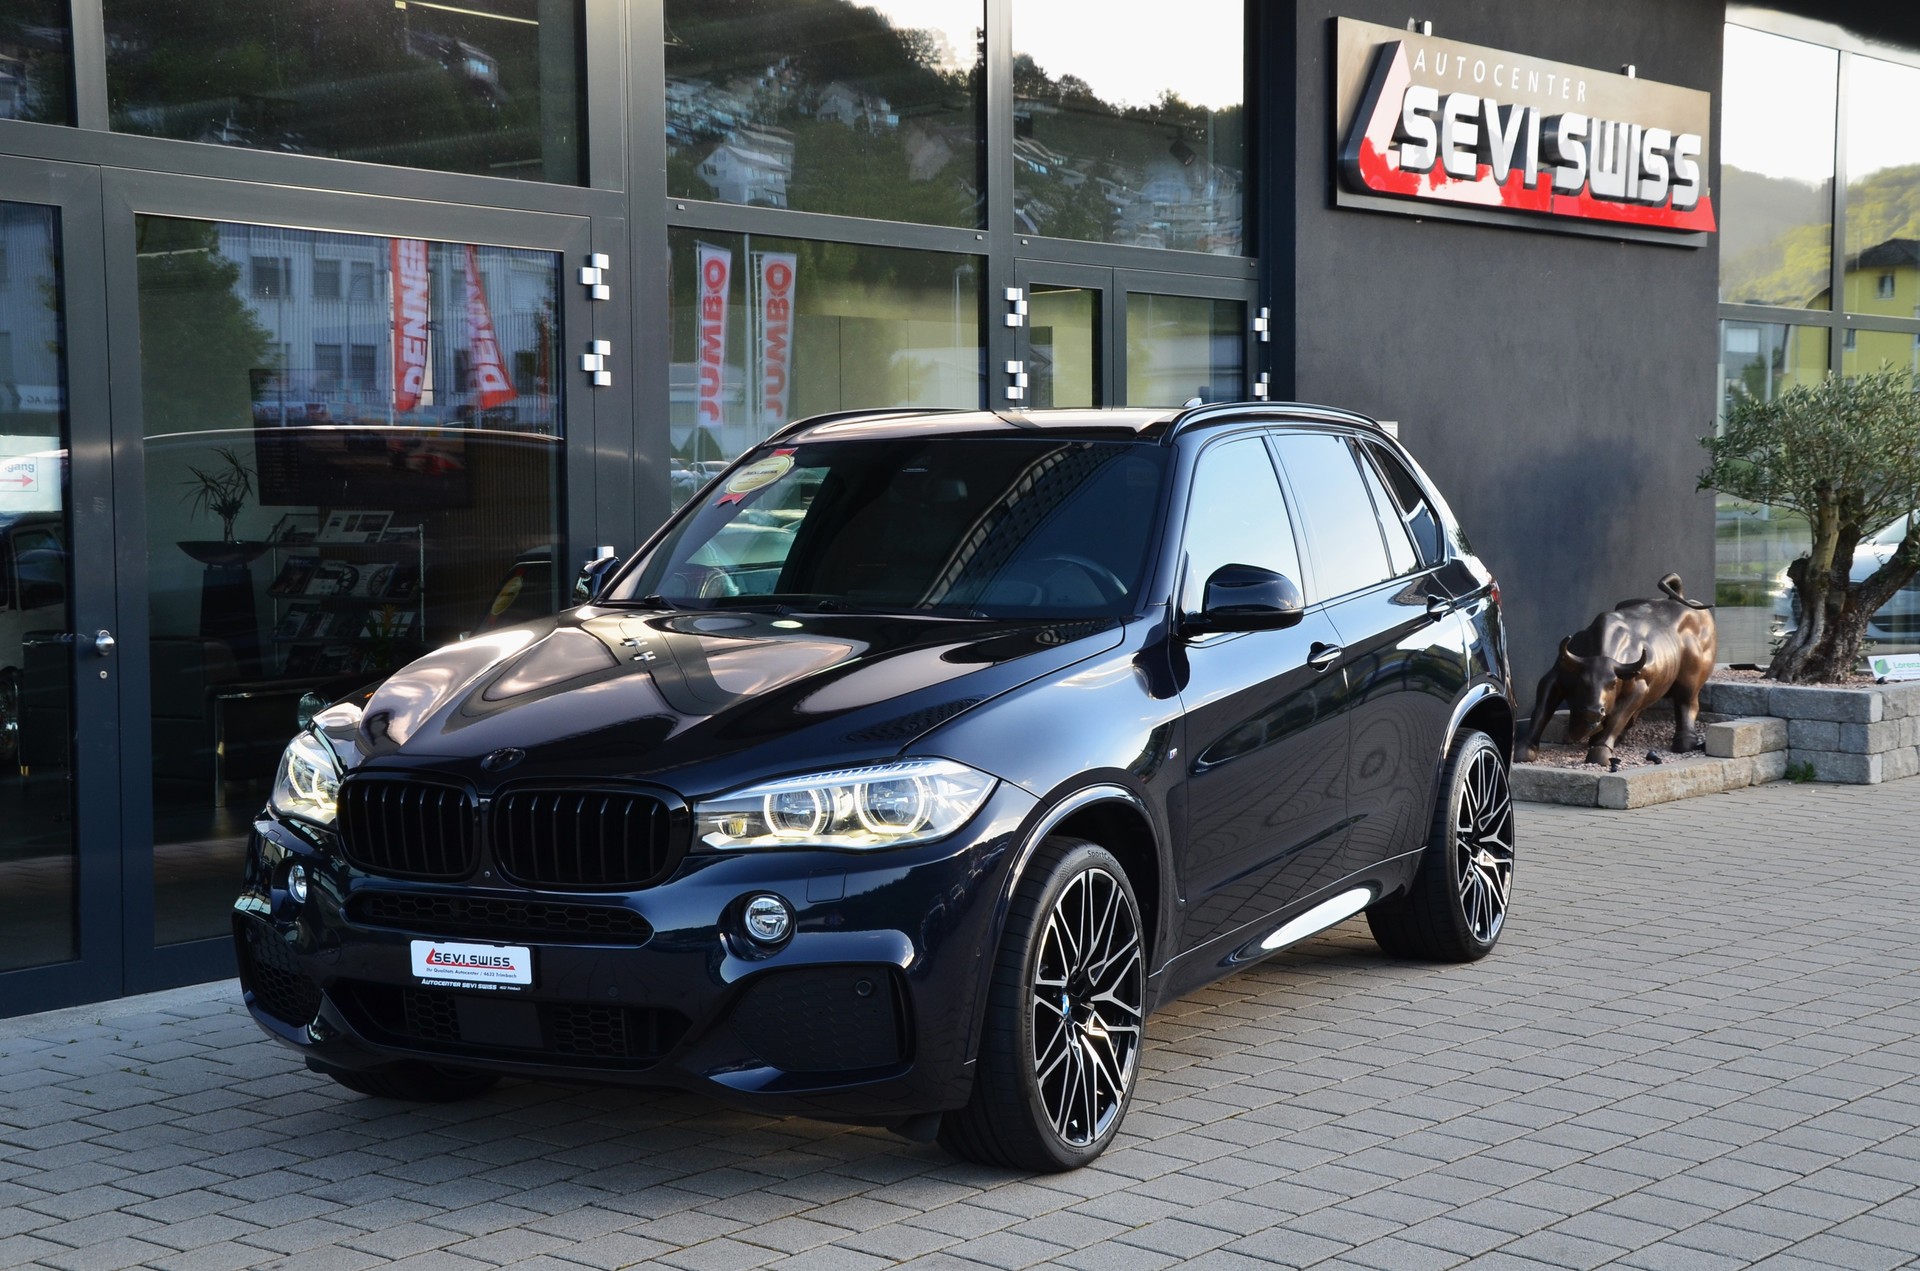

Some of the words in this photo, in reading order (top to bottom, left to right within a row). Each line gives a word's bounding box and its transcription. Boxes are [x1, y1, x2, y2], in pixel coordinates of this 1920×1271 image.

[1413, 48, 1587, 103] AUTOCENTER
[1399, 84, 1541, 189] SEVI
[1552, 112, 1702, 209] SWISS
[699, 259, 727, 422] JUMBO
[765, 263, 792, 418] JUMBO
[434, 952, 466, 964] SEVI
[469, 955, 510, 967] SWISS
